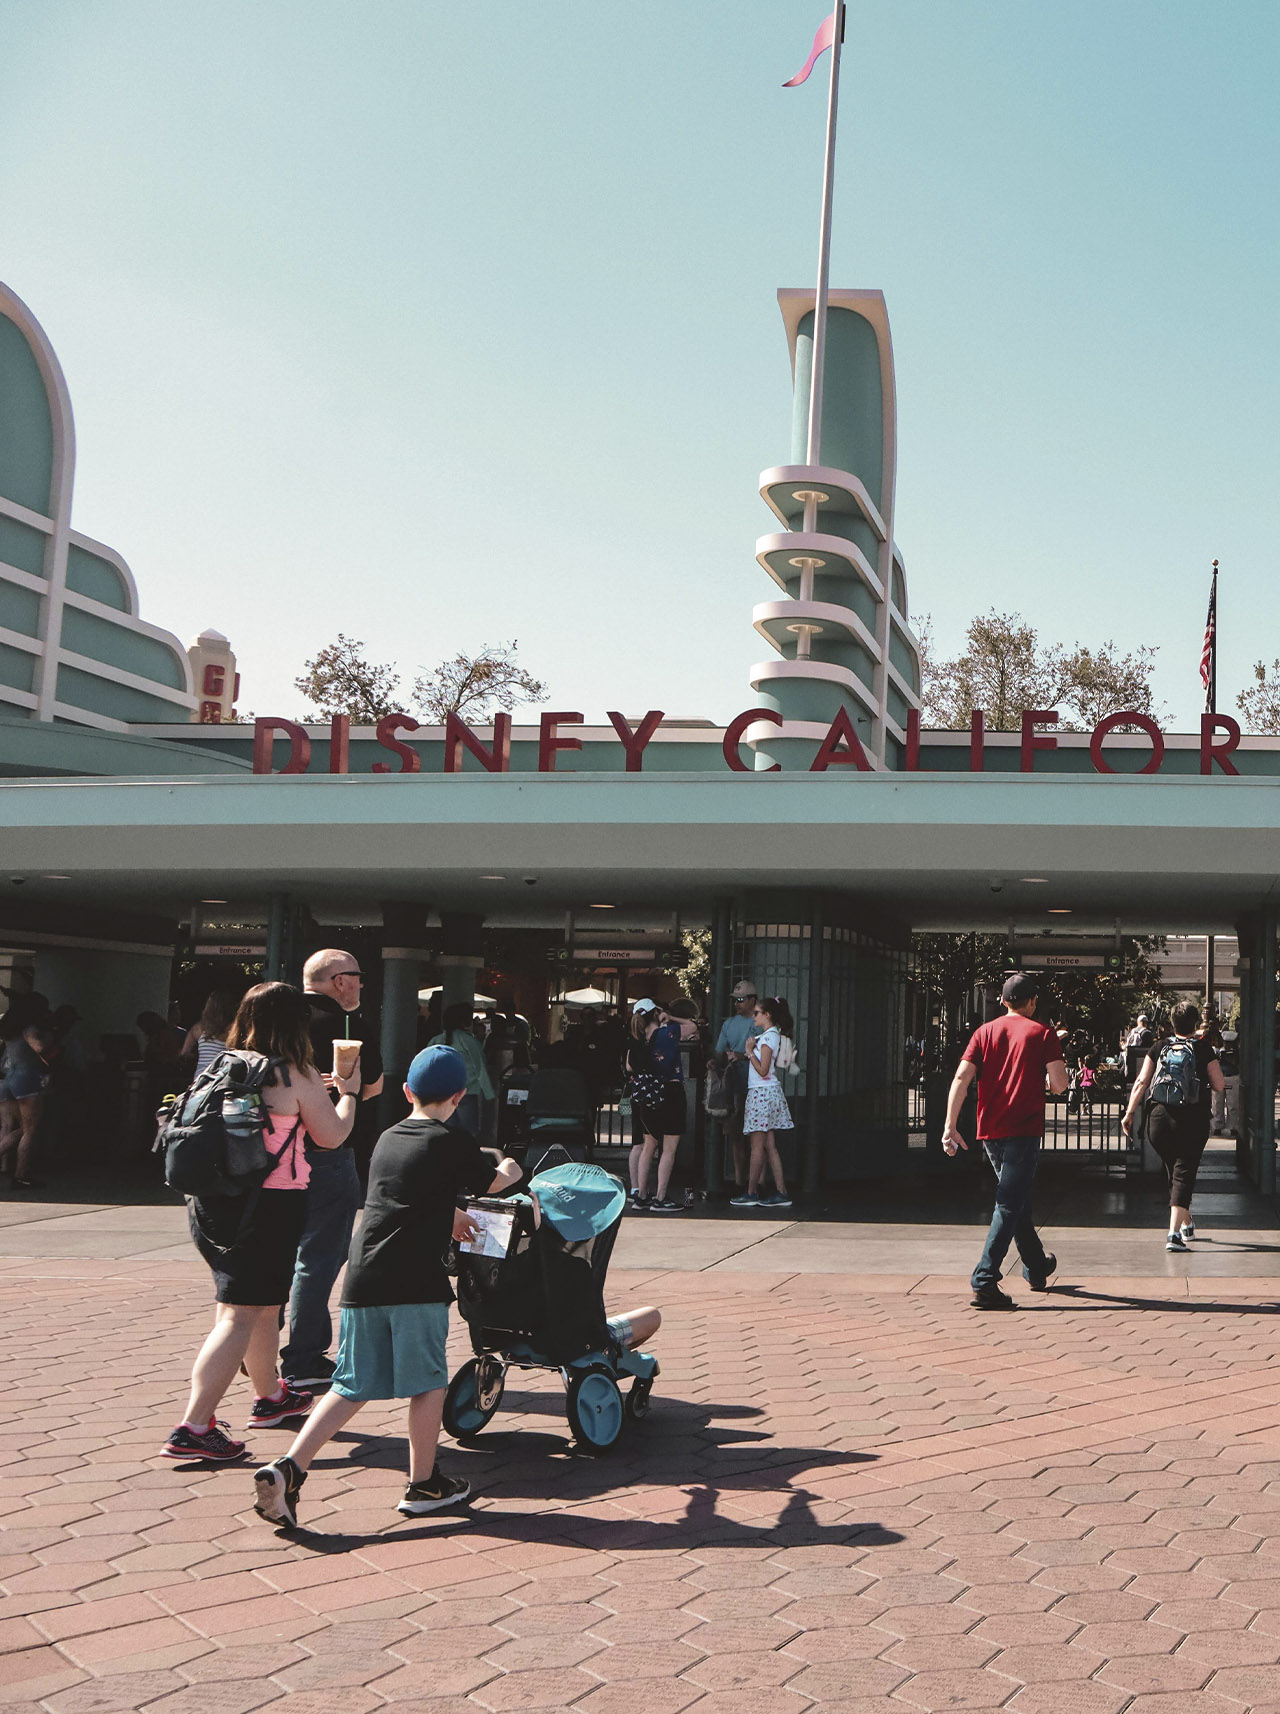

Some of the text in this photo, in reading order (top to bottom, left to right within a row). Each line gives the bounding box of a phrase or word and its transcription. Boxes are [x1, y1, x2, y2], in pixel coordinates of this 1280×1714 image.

[253, 711, 666, 775] DISNEY
[219, 946, 252, 954] Entrance
[1046, 957, 1080, 965] Entrance
